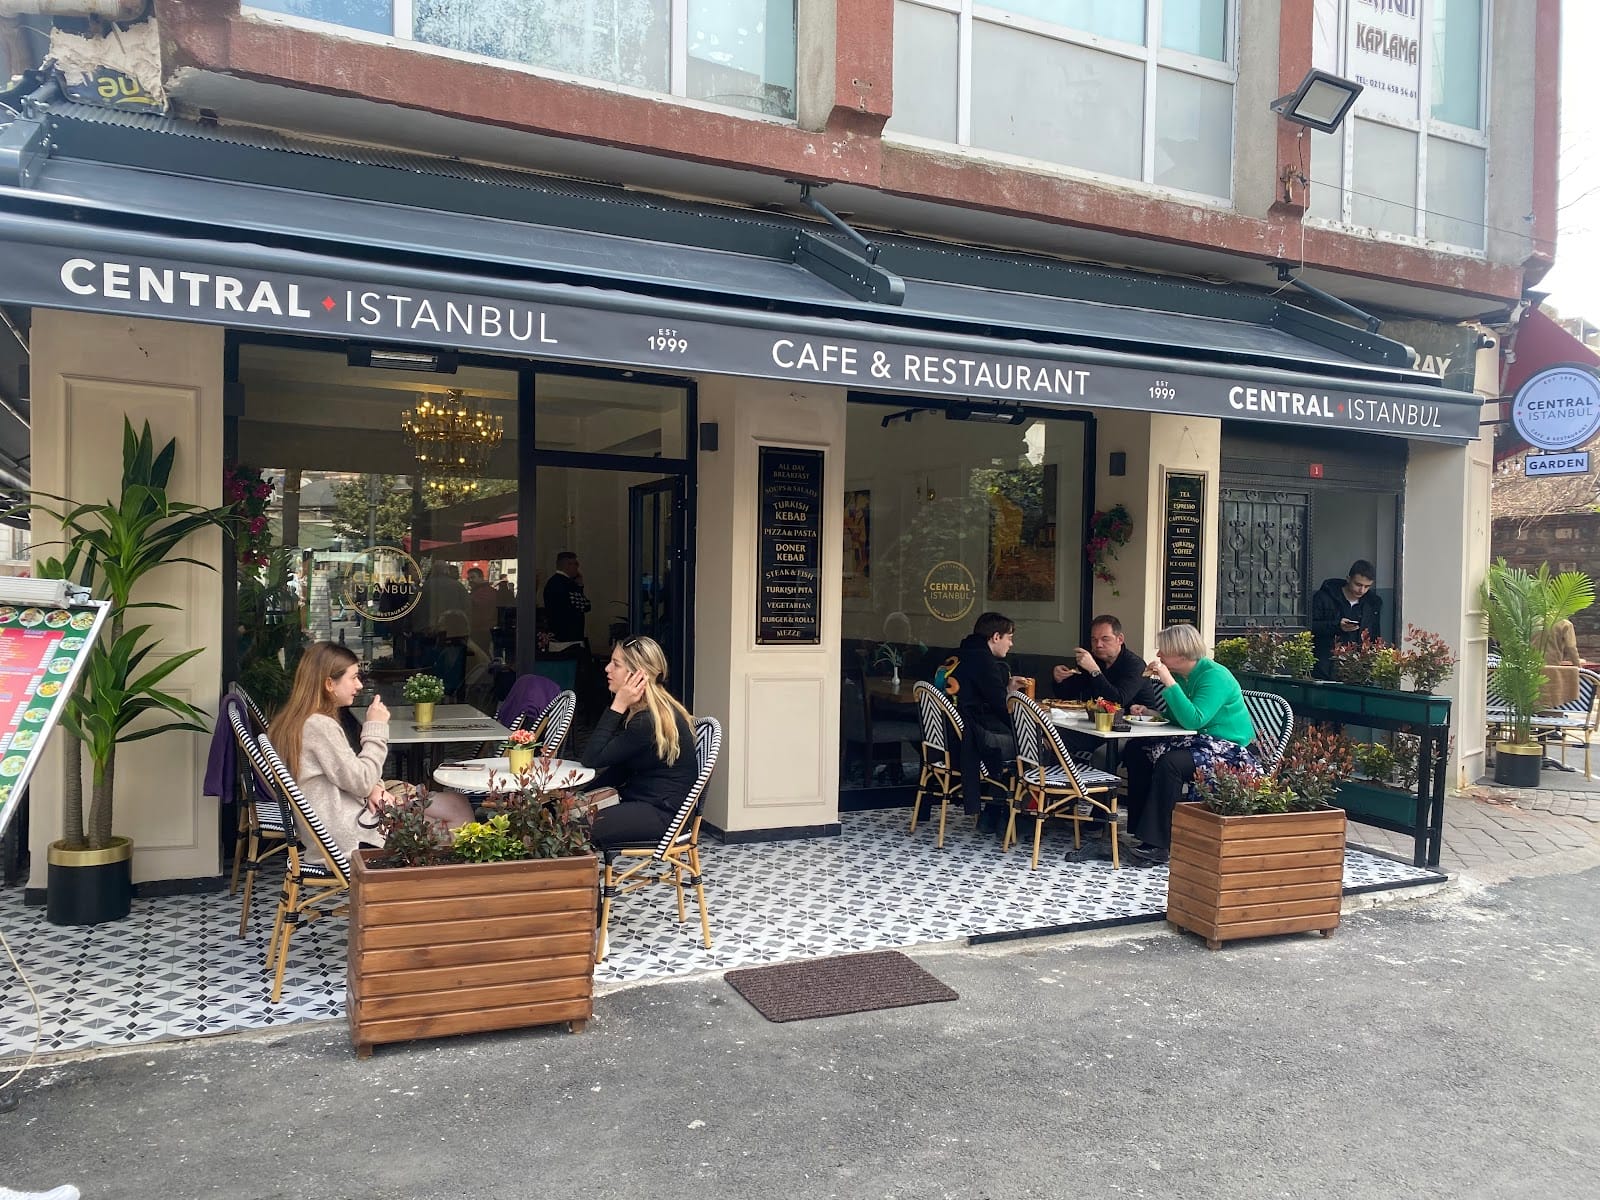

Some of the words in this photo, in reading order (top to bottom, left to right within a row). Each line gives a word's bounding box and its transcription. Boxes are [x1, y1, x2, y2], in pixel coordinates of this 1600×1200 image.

[1356, 22, 1417, 66] KAPLAMA
[1370, 79, 1385, 90] 0212
[60, 257, 311, 318] CENTRAL
[344, 289, 558, 344] ISTANBUL
[658, 328, 677, 336] EST
[647, 335, 688, 353] 1999
[771, 338, 858, 376] CAFE
[870, 350, 892, 379] &
[903, 354, 1091, 396] RESTAURANT
[1149, 386, 1176, 400] 1999
[1228, 385, 1335, 418] CENTRAL
[1347, 398, 1442, 428] ISTANBUL
[1527, 396, 1593, 411] CENTRAL
[1528, 407, 1593, 421] ISTANBUL
[1529, 458, 1585, 470] GARDEN
[772, 500, 809, 512] TURKISH
[775, 511, 807, 521] KEBAB
[764, 528, 787, 536] PIZZA
[794, 529, 817, 537] PASTA
[775, 543, 806, 552] DONER
[776, 552, 805, 562] KEBAB
[352, 571, 415, 584] CENTRAL
[354, 583, 415, 595] ISTANBUL
[765, 586, 797, 594] TURKISH
[797, 586, 813, 594] PITA
[929, 582, 971, 592] CENTRAL
[930, 591, 971, 600] ISTANBUL
[766, 601, 812, 609] VEGETARIAN
[776, 629, 801, 638] MEZZE
